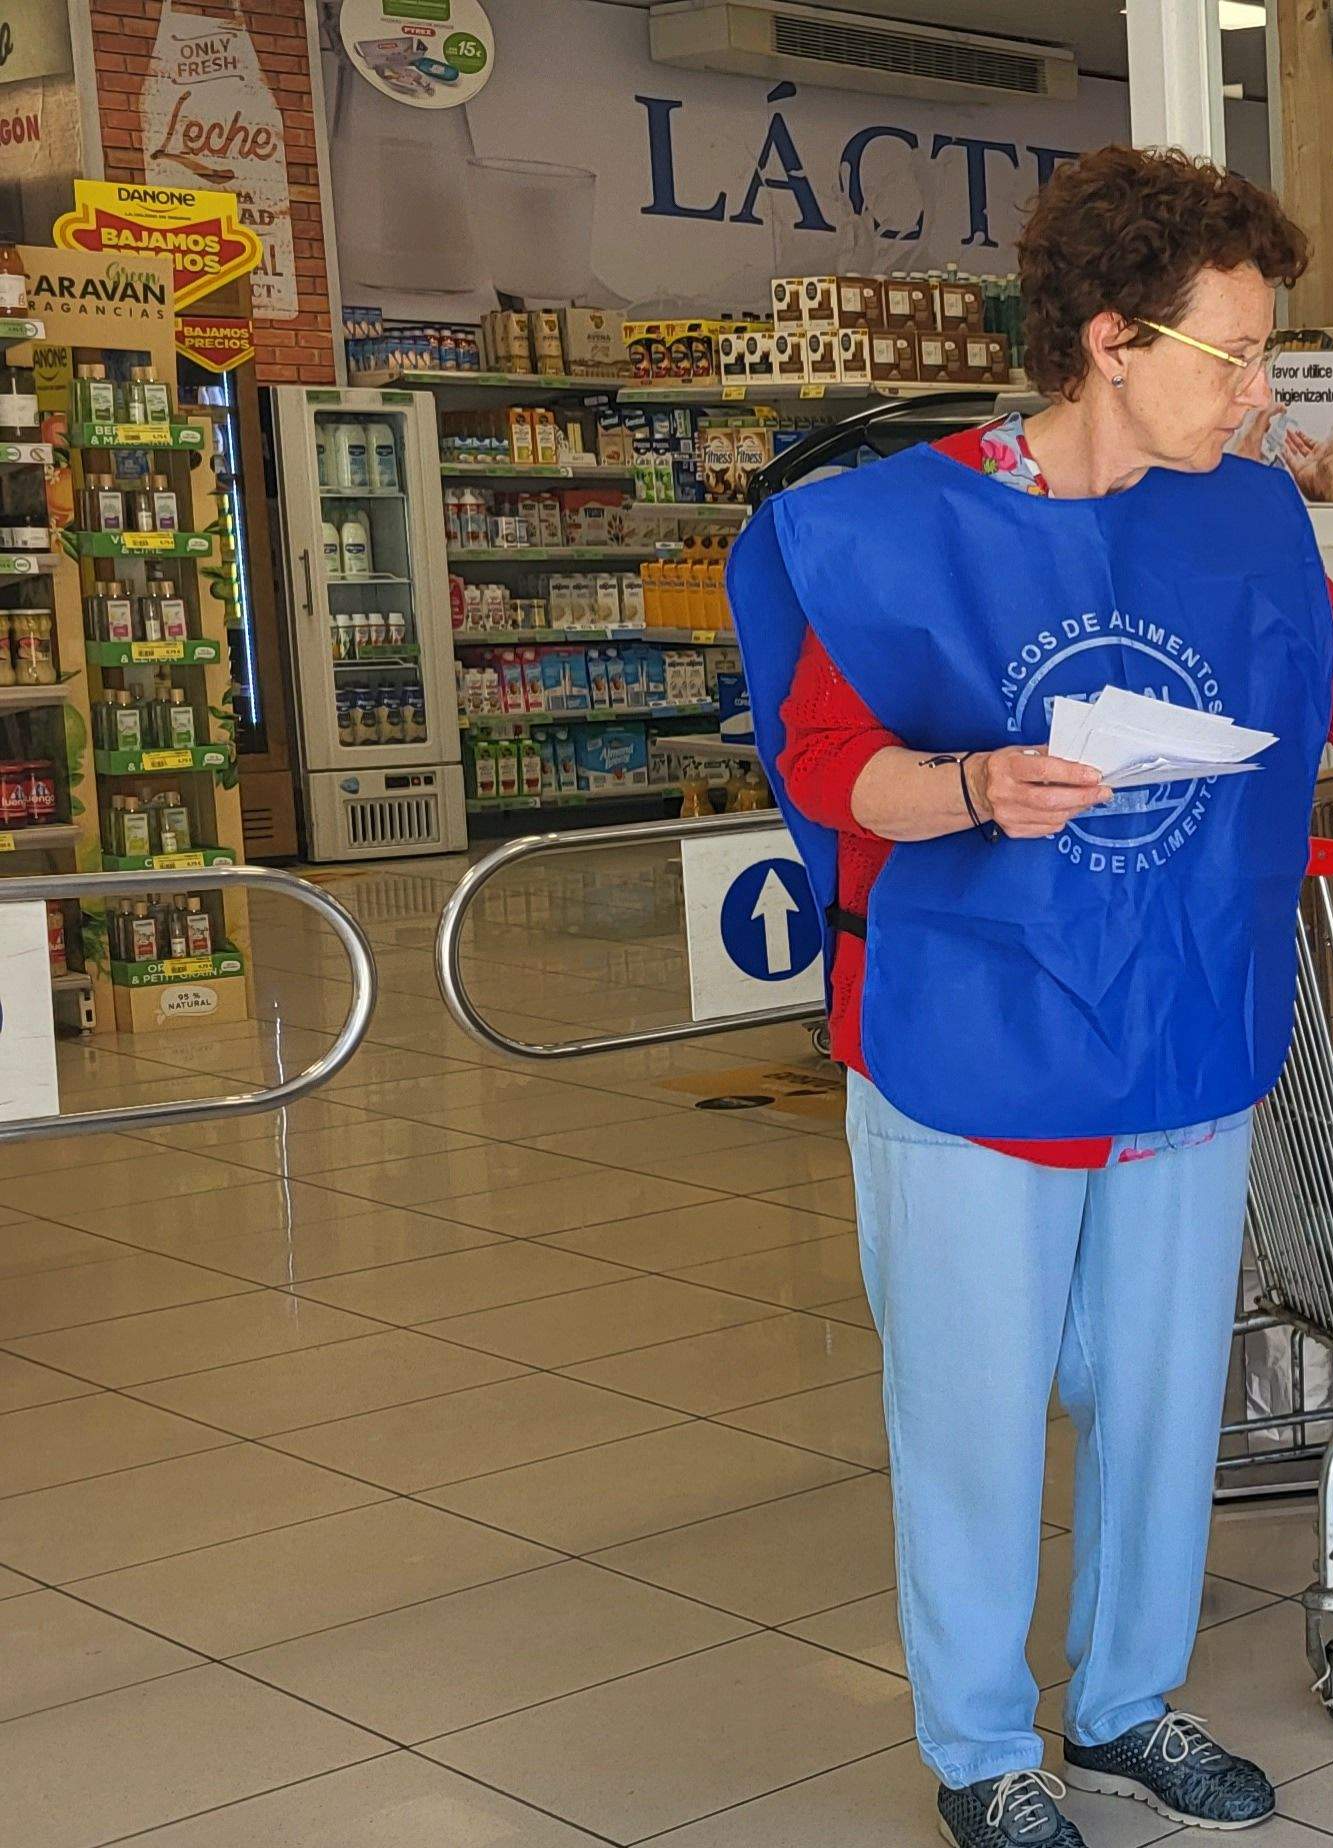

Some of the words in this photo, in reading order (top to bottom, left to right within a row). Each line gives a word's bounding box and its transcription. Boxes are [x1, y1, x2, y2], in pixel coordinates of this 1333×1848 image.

[181, 38, 231, 60] ONLY
[177, 56, 237, 78] FRESH
[151, 90, 278, 161] Leche
[100, 227, 221, 252] BAJAMOS
[27, 301, 165, 320] RAGANCIAS
[183, 326, 249, 339] BAJAMOS
[184, 338, 250, 350] PRECIOS
[704, 445, 734, 465] Fitness
[736, 445, 764, 464] Fitness
[1061, 612, 1102, 640] DE
[1108, 610, 1225, 716] ALIMENTOS
[1089, 853, 1127, 875] DE
[168, 1000, 212, 1010] NATURAL
